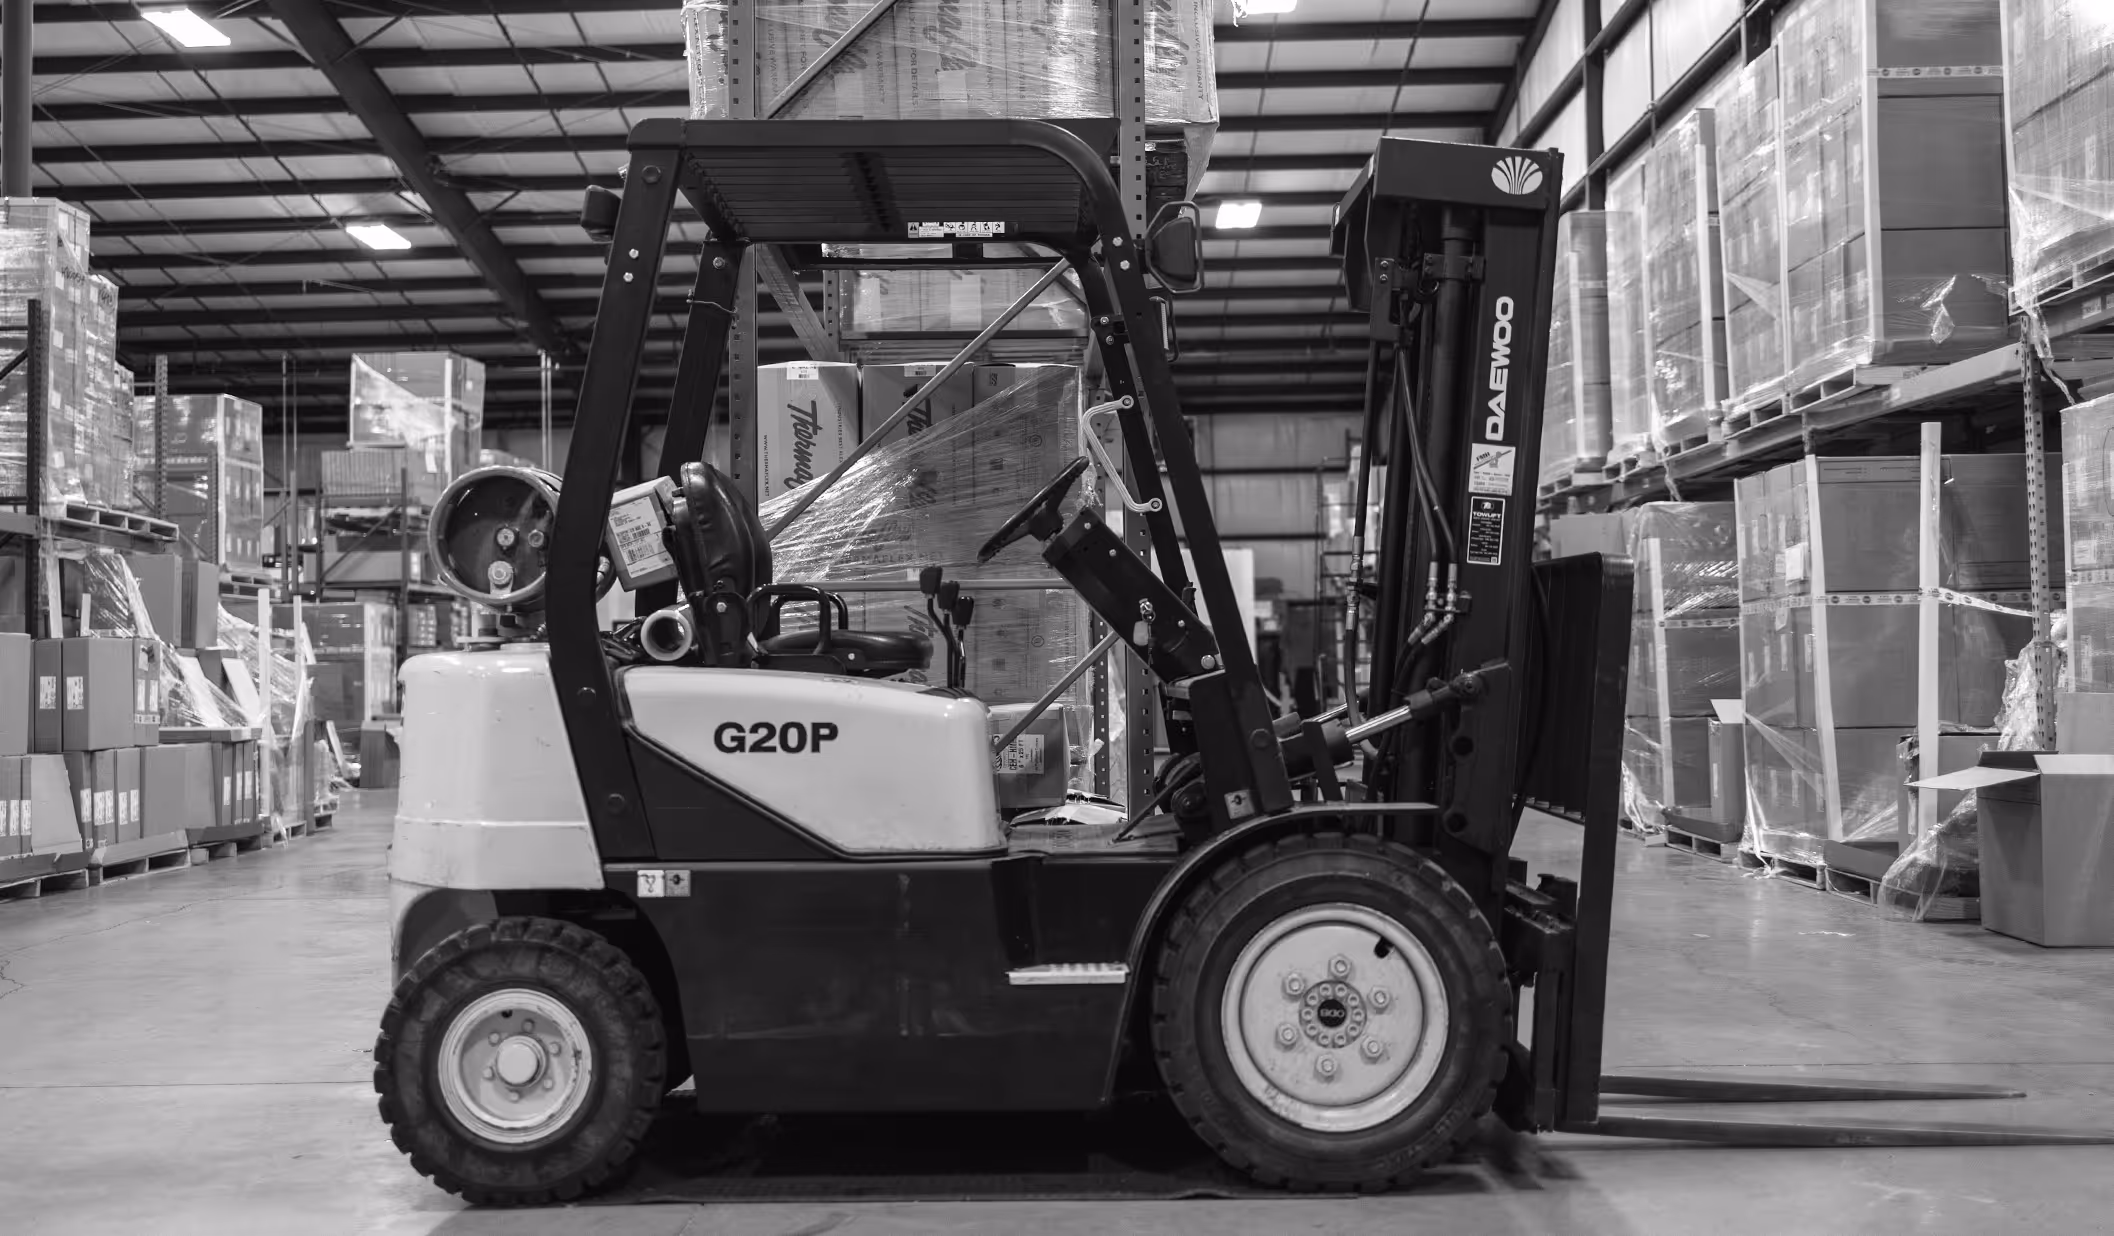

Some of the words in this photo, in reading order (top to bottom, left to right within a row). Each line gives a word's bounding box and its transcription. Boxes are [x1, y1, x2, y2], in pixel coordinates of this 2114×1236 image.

[911, 68, 919, 105] DETAILS
[1195, 49, 1204, 101] WARRANTY
[1485, 296, 1514, 441] DAEWOO
[714, 722, 839, 754] G20P
